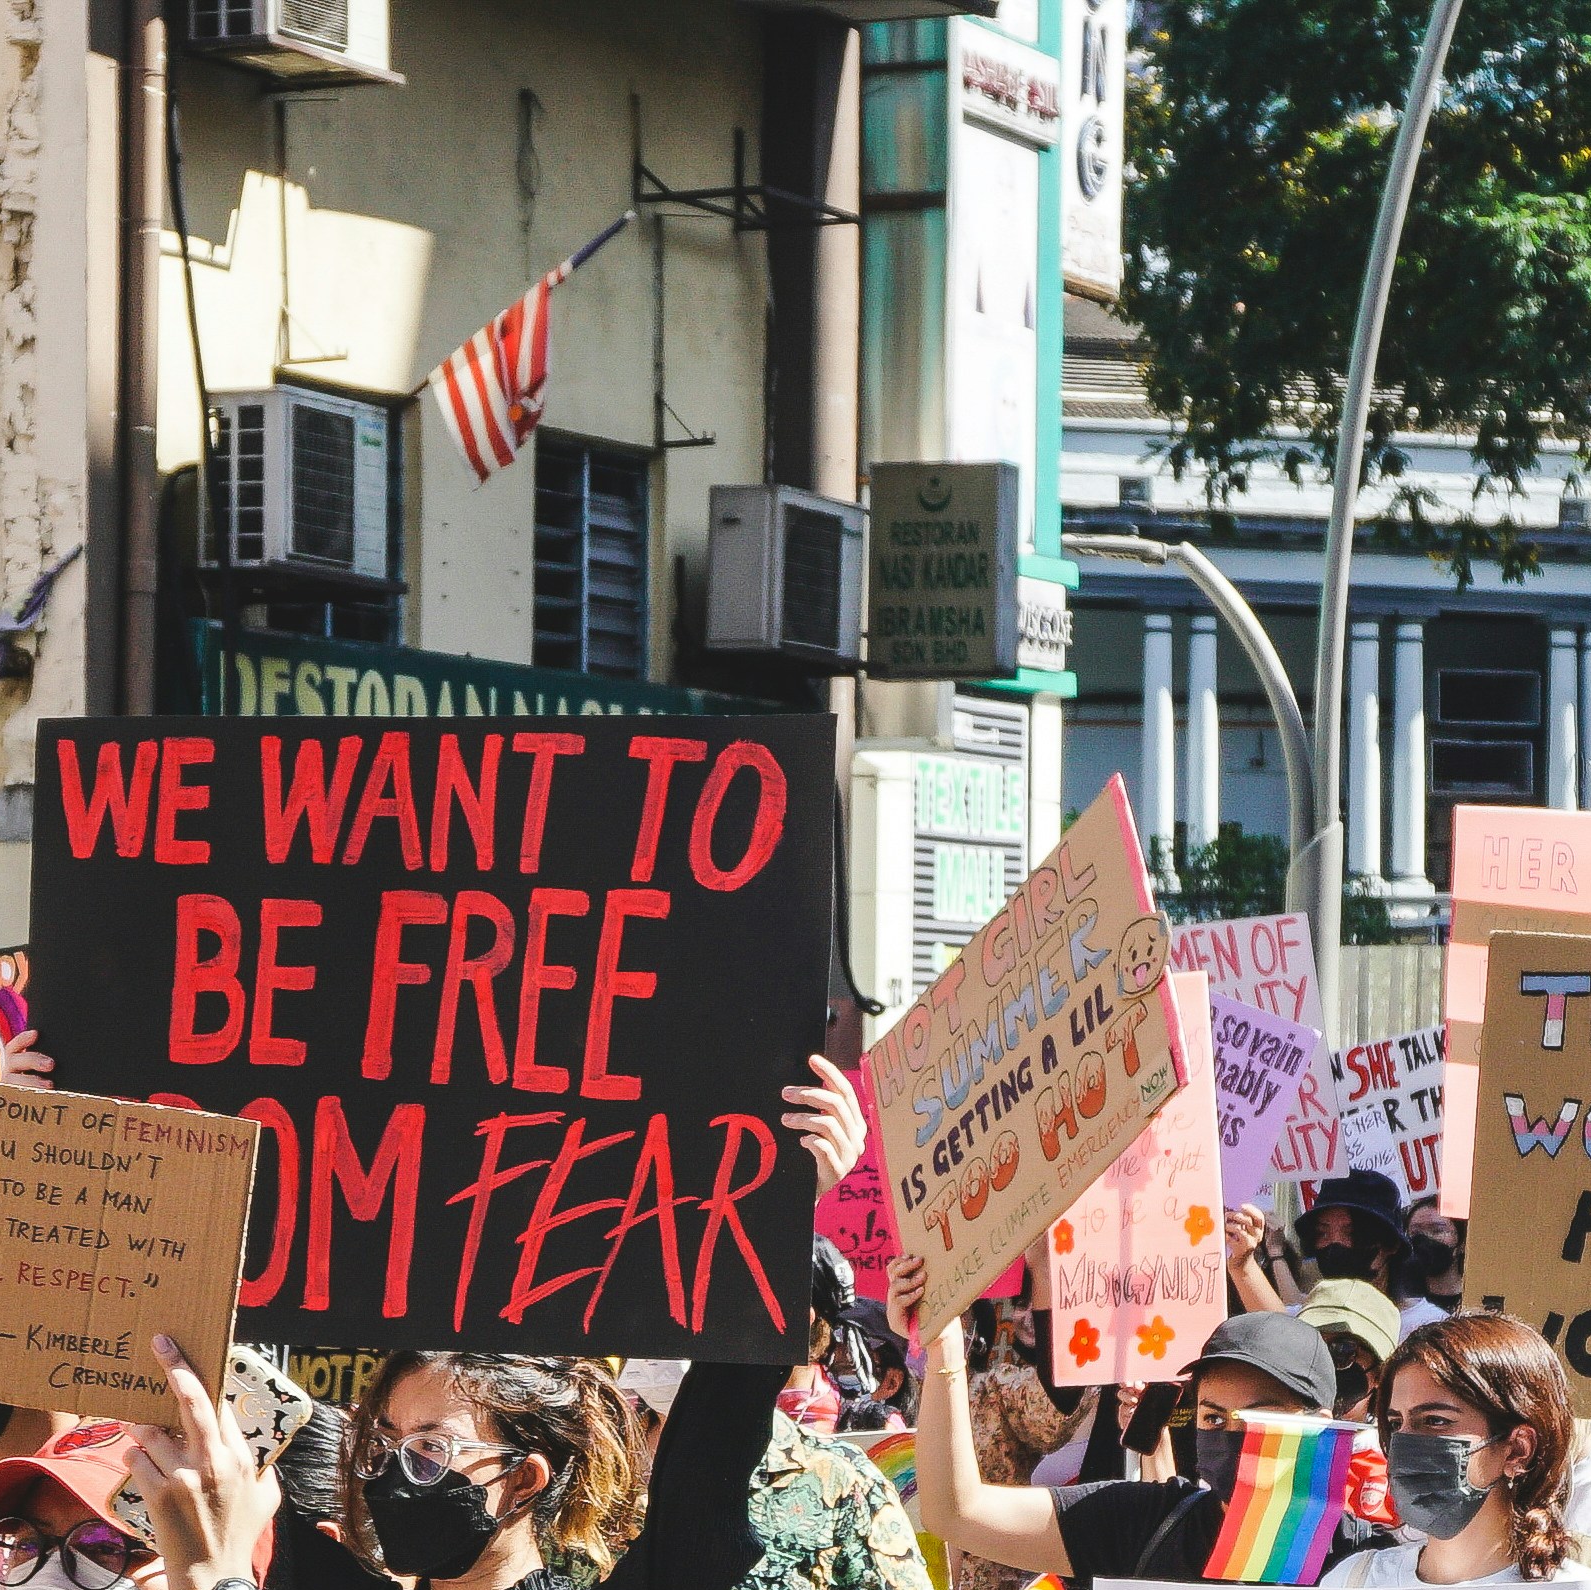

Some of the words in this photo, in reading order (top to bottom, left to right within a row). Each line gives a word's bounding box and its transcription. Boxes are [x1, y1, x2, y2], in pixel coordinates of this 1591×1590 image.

[57, 734, 215, 864] WE
[260, 731, 585, 874] WANT
[628, 737, 789, 892] TO
[914, 757, 1026, 838] TEXTILE
[934, 847, 1005, 920] MALL
[1482, 835, 1579, 895] HER
[870, 957, 967, 1108] HOT
[981, 841, 1098, 988] GIRL
[1250, 916, 1301, 977] OF
[169, 893, 323, 1066] BE
[361, 889, 671, 1102] FREE
[911, 898, 1112, 1148] SUMMER
[901, 1163, 927, 1214] IS
[932, 1055, 1034, 1177] GETTING
[1040, 1034, 1059, 1076] A
[1069, 983, 1114, 1048] LIL
[1346, 1039, 1401, 1102] SHE
[81, 1112, 115, 1132] OF
[121, 1116, 252, 1161] FEMINISM
[922, 1130, 1021, 1252] TOO
[1034, 1000, 1149, 1162] HOT
[32, 1141, 165, 1181] SHOULDN'T
[989, 1183, 1052, 1256] CLIMATE
[1139, 1062, 1170, 1097] NOW
[1156, 1144, 1205, 1188] right
[0, 1178, 26, 1198] TO
[35, 1182, 63, 1206] BE
[74, 1186, 89, 1206] A
[101, 1187, 153, 1215] MAN
[446, 1111, 788, 1337] FEAR
[1080, 1206, 1109, 1235] to
[1121, 1198, 1147, 1229] be
[1162, 1196, 1187, 1222] a
[5, 1216, 111, 1251] TREATED
[127, 1233, 188, 1262] WITH
[1059, 1251, 1223, 1311] MISOGYNIST
[25, 1323, 133, 1361] KIMBERLÉ
[48, 1362, 170, 1396] CRENSHAW
